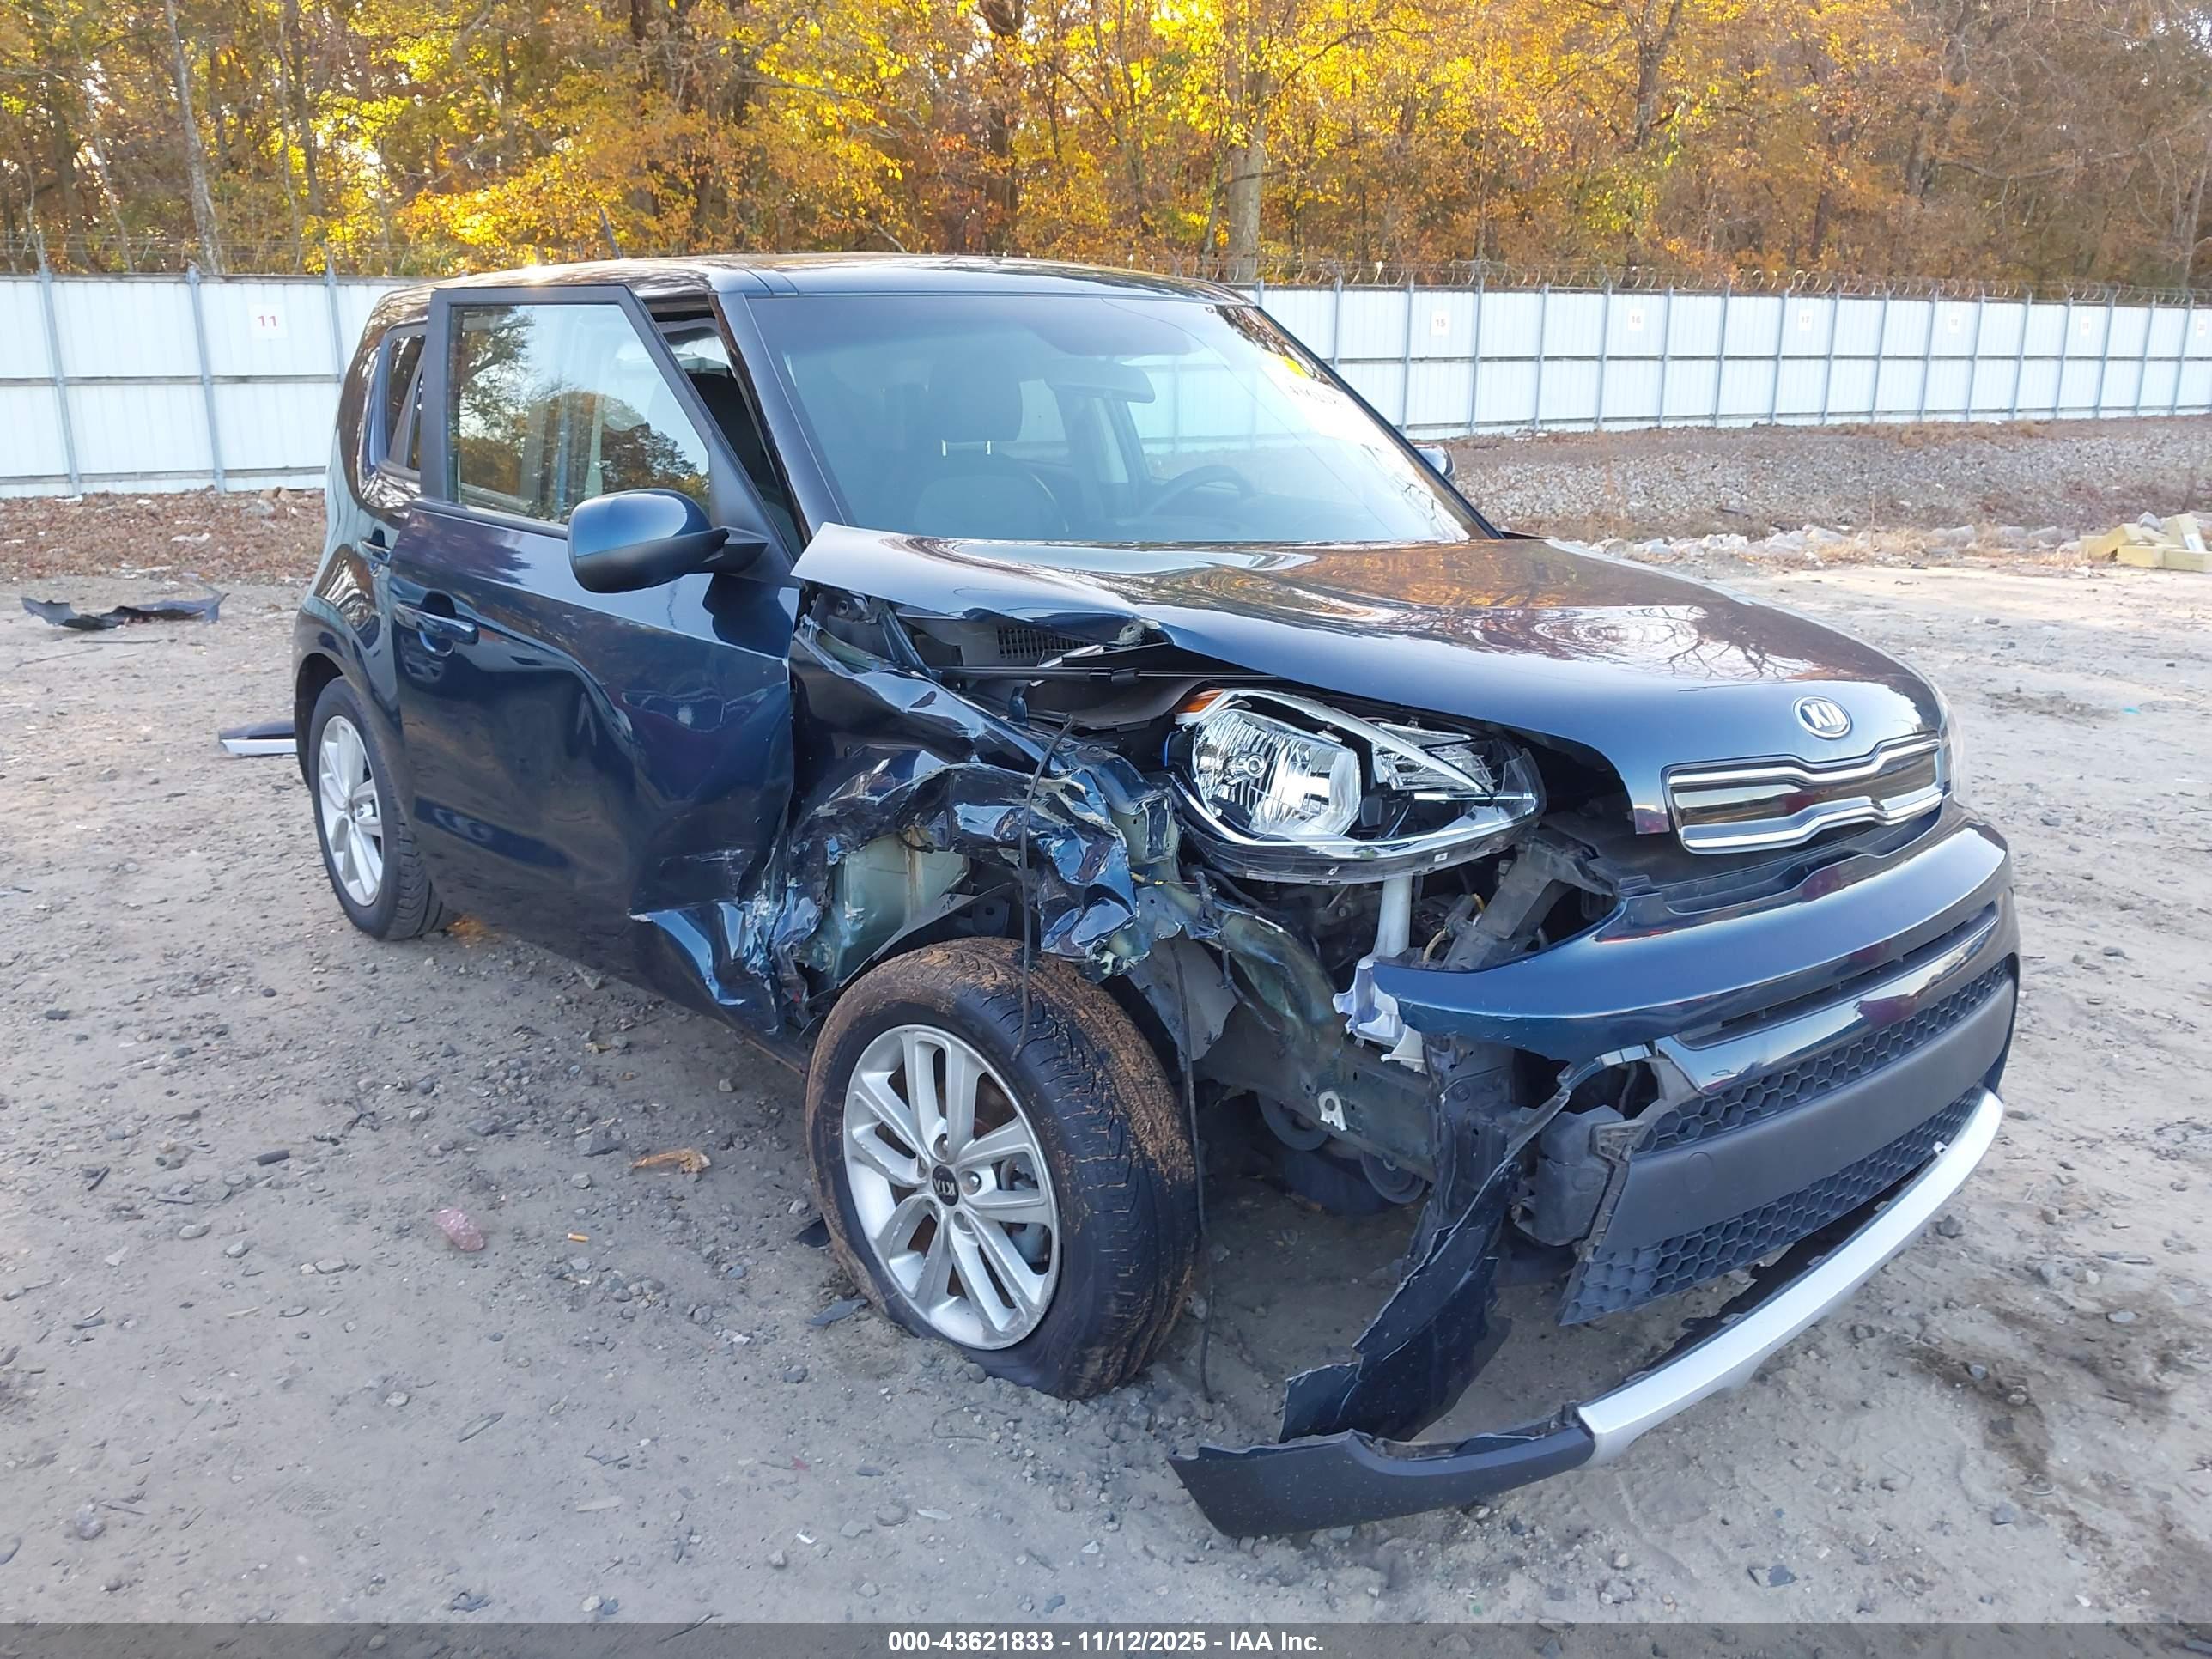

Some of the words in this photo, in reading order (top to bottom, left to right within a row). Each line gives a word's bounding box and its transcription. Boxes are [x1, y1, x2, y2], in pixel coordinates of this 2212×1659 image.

[258, 315, 277, 327] 11
[1435, 318, 1447, 329] 15
[1802, 702, 1848, 729] KIA
[933, 1179, 955, 1196] KIA
